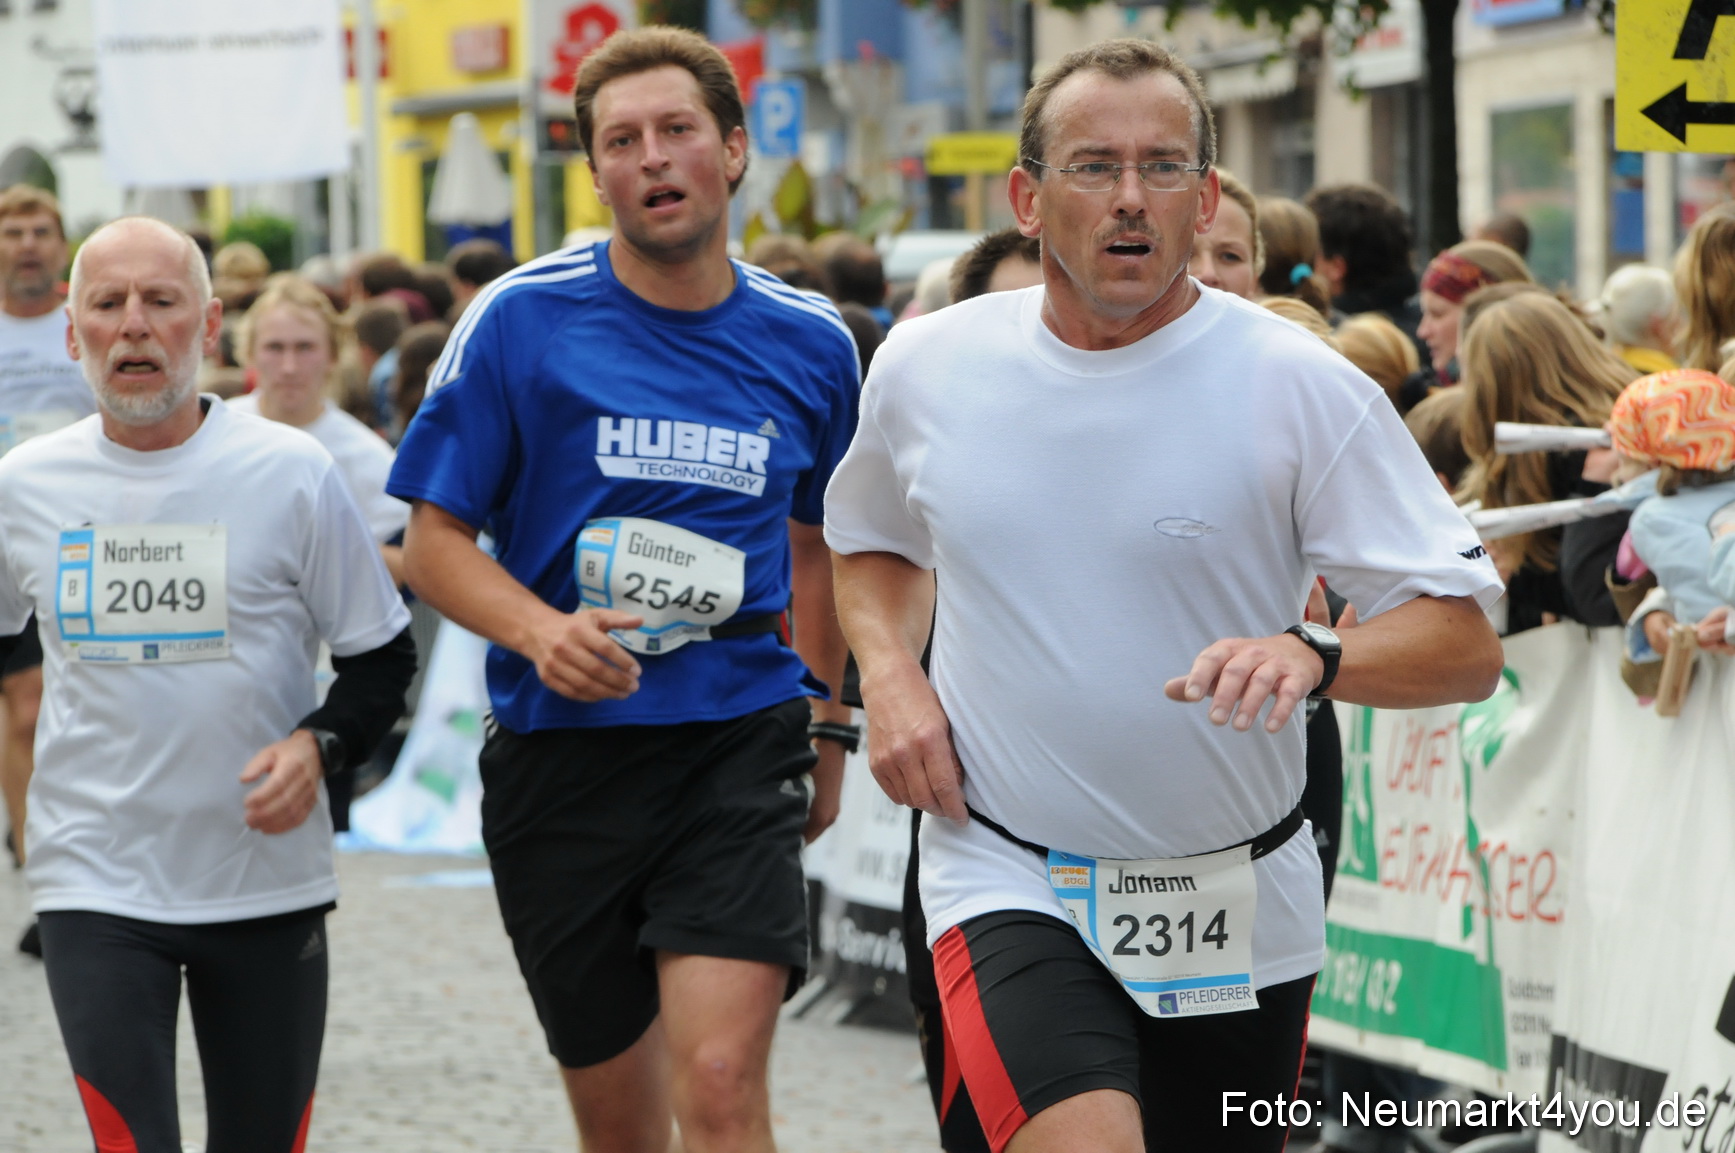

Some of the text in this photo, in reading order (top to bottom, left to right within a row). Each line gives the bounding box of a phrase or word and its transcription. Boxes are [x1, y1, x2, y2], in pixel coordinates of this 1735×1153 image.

[597, 416, 770, 475] HUBER
[636, 461, 757, 491] TECHNOLOGY
[103, 538, 183, 563] Norbert
[628, 531, 696, 567] Günter
[585, 560, 596, 577] B
[67, 579, 77, 597] B
[106, 578, 206, 614] 2049
[623, 572, 721, 614] 2545
[1108, 869, 1198, 895] Johann
[1112, 909, 1229, 957] 2314
[1179, 986, 1252, 1005] PFLEIDERER
[1181, 1000, 1254, 1014] AKTIENGESELLSCHAFT
